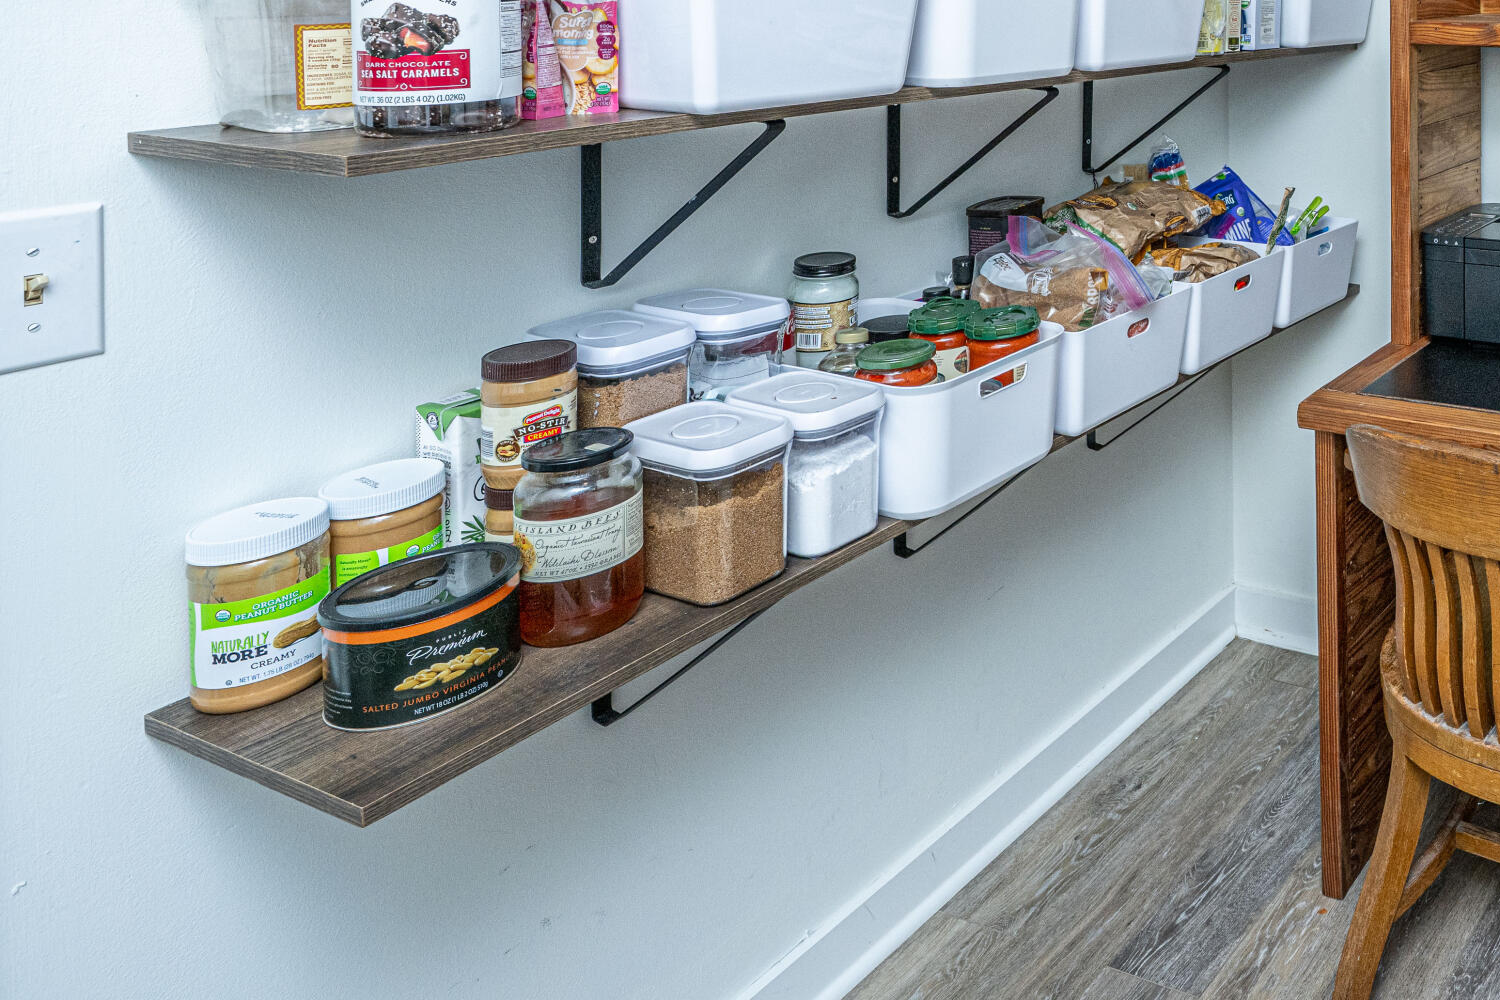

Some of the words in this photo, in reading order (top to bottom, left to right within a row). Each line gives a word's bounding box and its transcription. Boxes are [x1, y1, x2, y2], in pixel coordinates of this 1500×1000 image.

[361, 69, 374, 79] SEA
[376, 69, 398, 79] SALT
[401, 67, 460, 78] CARAMELS
[388, 60, 451, 68] CHOCOLATE
[422, 95, 435, 104] OZ)
[437, 94, 466, 103] (1.02KG)
[518, 417, 566, 436] NO-STIR
[527, 428, 559, 441] CREAMY
[525, 524, 577, 534] ISLAND
[581, 510, 621, 530] BEES
[422, 539, 440, 552] PEAN
[234, 606, 278, 622] PEANUT
[278, 590, 313, 610] BUTTER
[252, 590, 299, 610] ORGANIC
[211, 631, 269, 653] NATURALLY
[435, 629, 467, 644] PUBLIX
[212, 645, 268, 665] MORE
[406, 628, 488, 666] Premium
[250, 649, 297, 670] CREAMY
[239, 675, 250, 683] NET
[362, 702, 399, 713] SALTED
[403, 691, 440, 707] JUMBO
[443, 671, 485, 695] VIRGINIA
[444, 699, 451, 708] OZ
